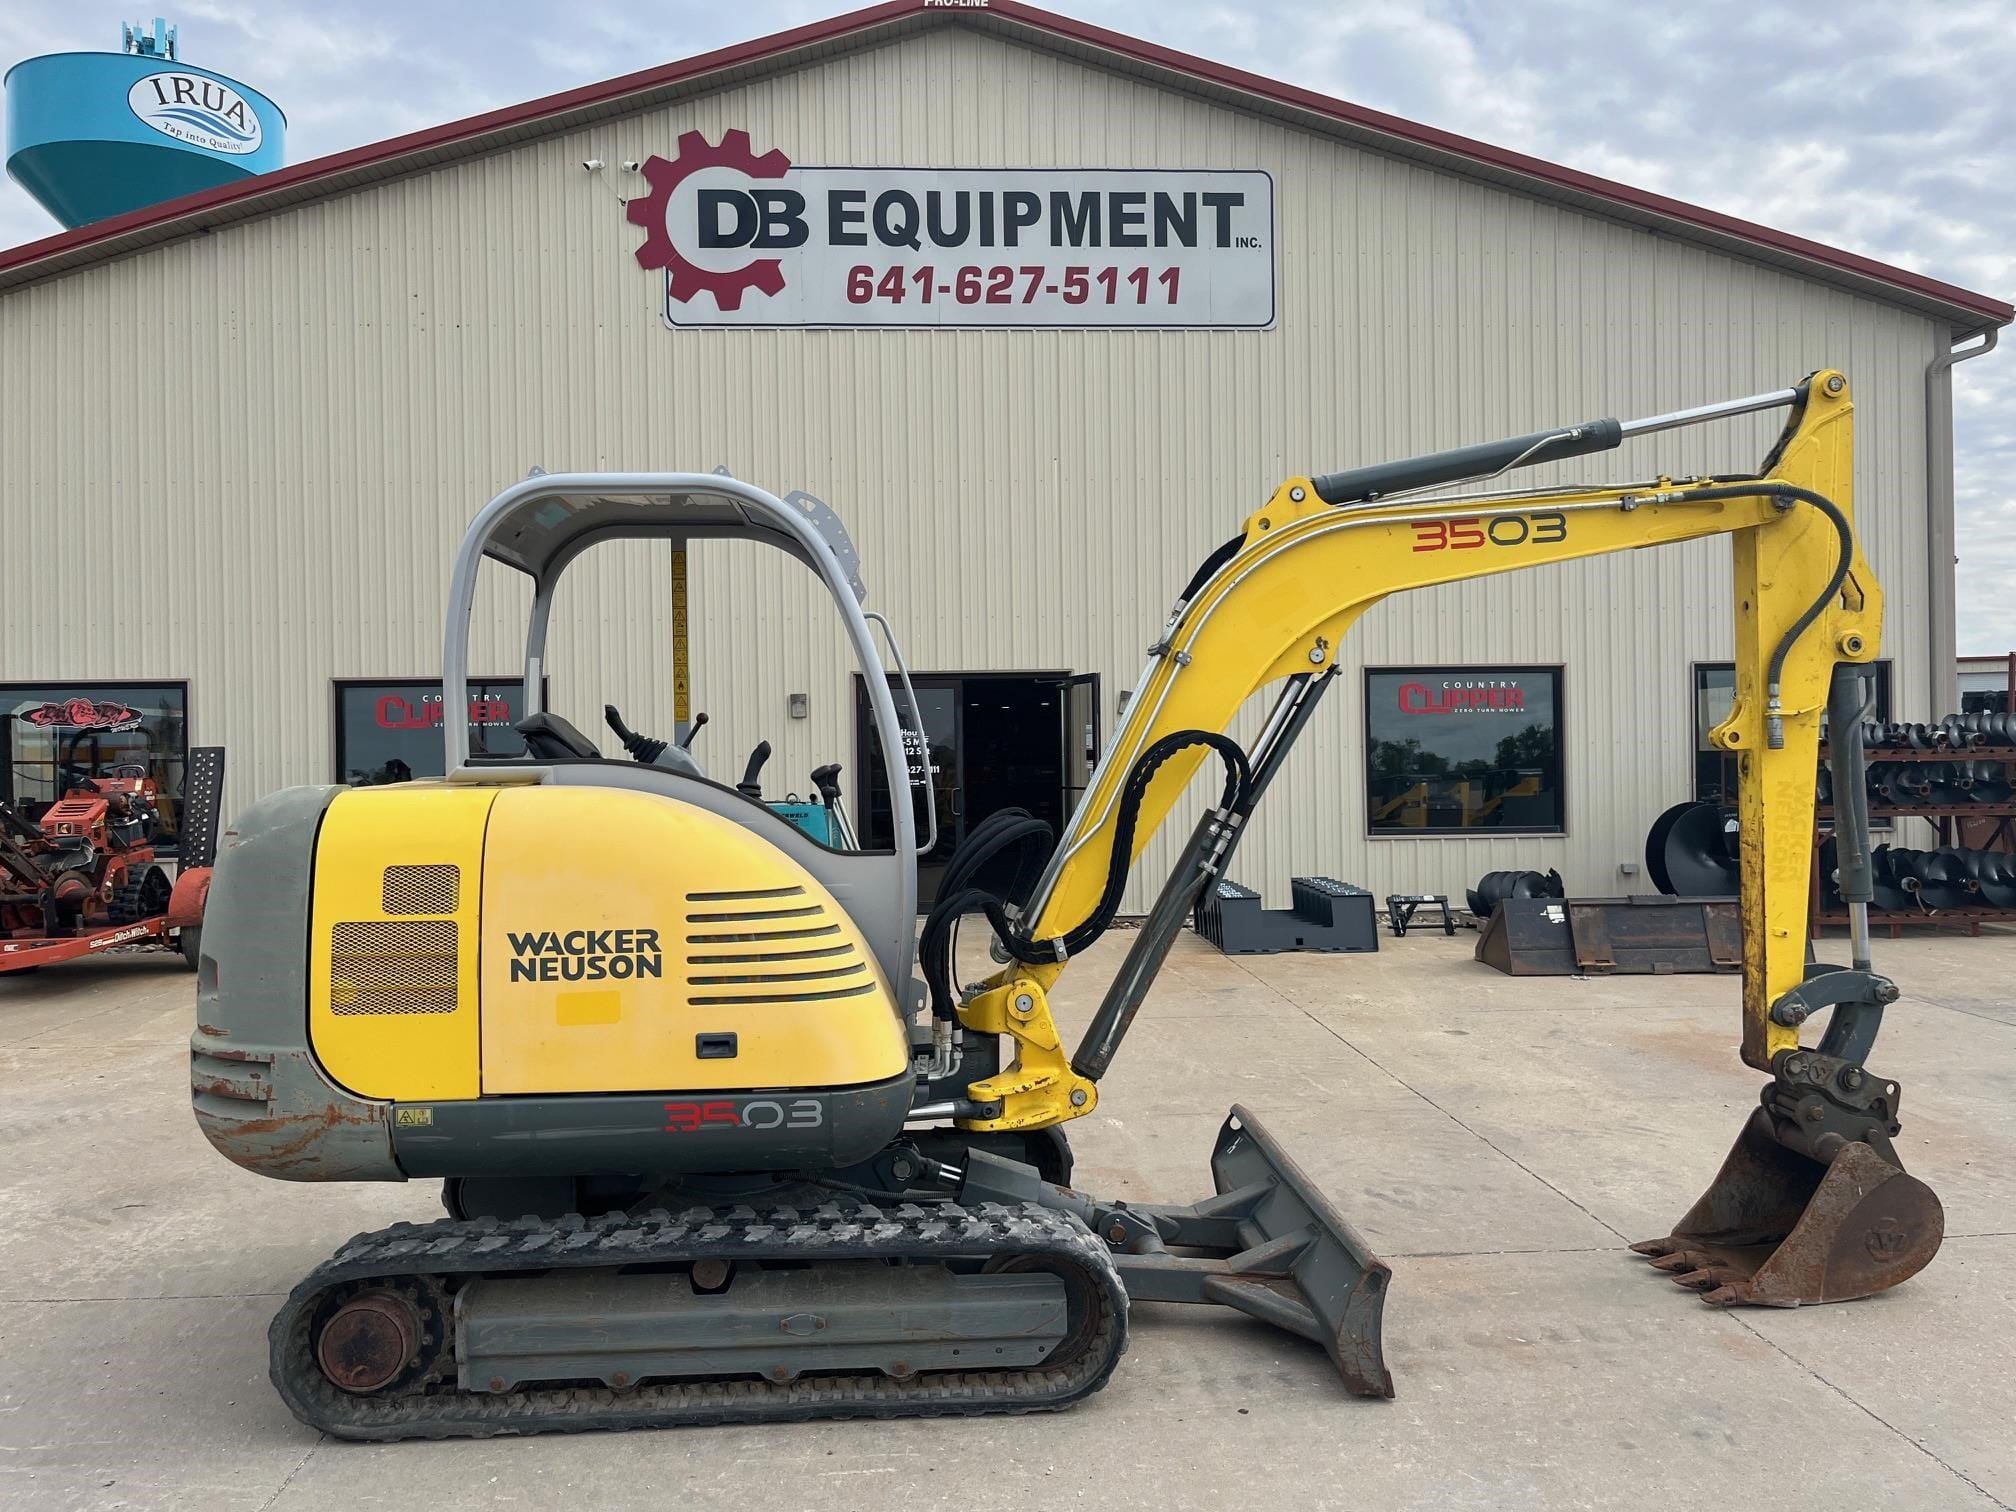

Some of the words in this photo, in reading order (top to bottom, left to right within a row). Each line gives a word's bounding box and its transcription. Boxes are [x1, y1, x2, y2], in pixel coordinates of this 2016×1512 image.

[148, 76, 246, 131] IRUA
[163, 121, 182, 137] Tap
[185, 130, 206, 144] into
[697, 189, 810, 249] DB
[828, 189, 1245, 252] EQUIPMENT
[1235, 236, 1262, 249] INC.
[847, 265, 1180, 305] 641-627-5111
[1411, 513, 1567, 552] 3503
[422, 694, 502, 702] COTRY
[1399, 683, 1524, 714] CLIPPER
[1443, 681, 1517, 689] COUNTRY
[375, 695, 511, 729] CLIPER
[506, 929, 662, 957] WACKER
[510, 954, 662, 982] NEUSON
